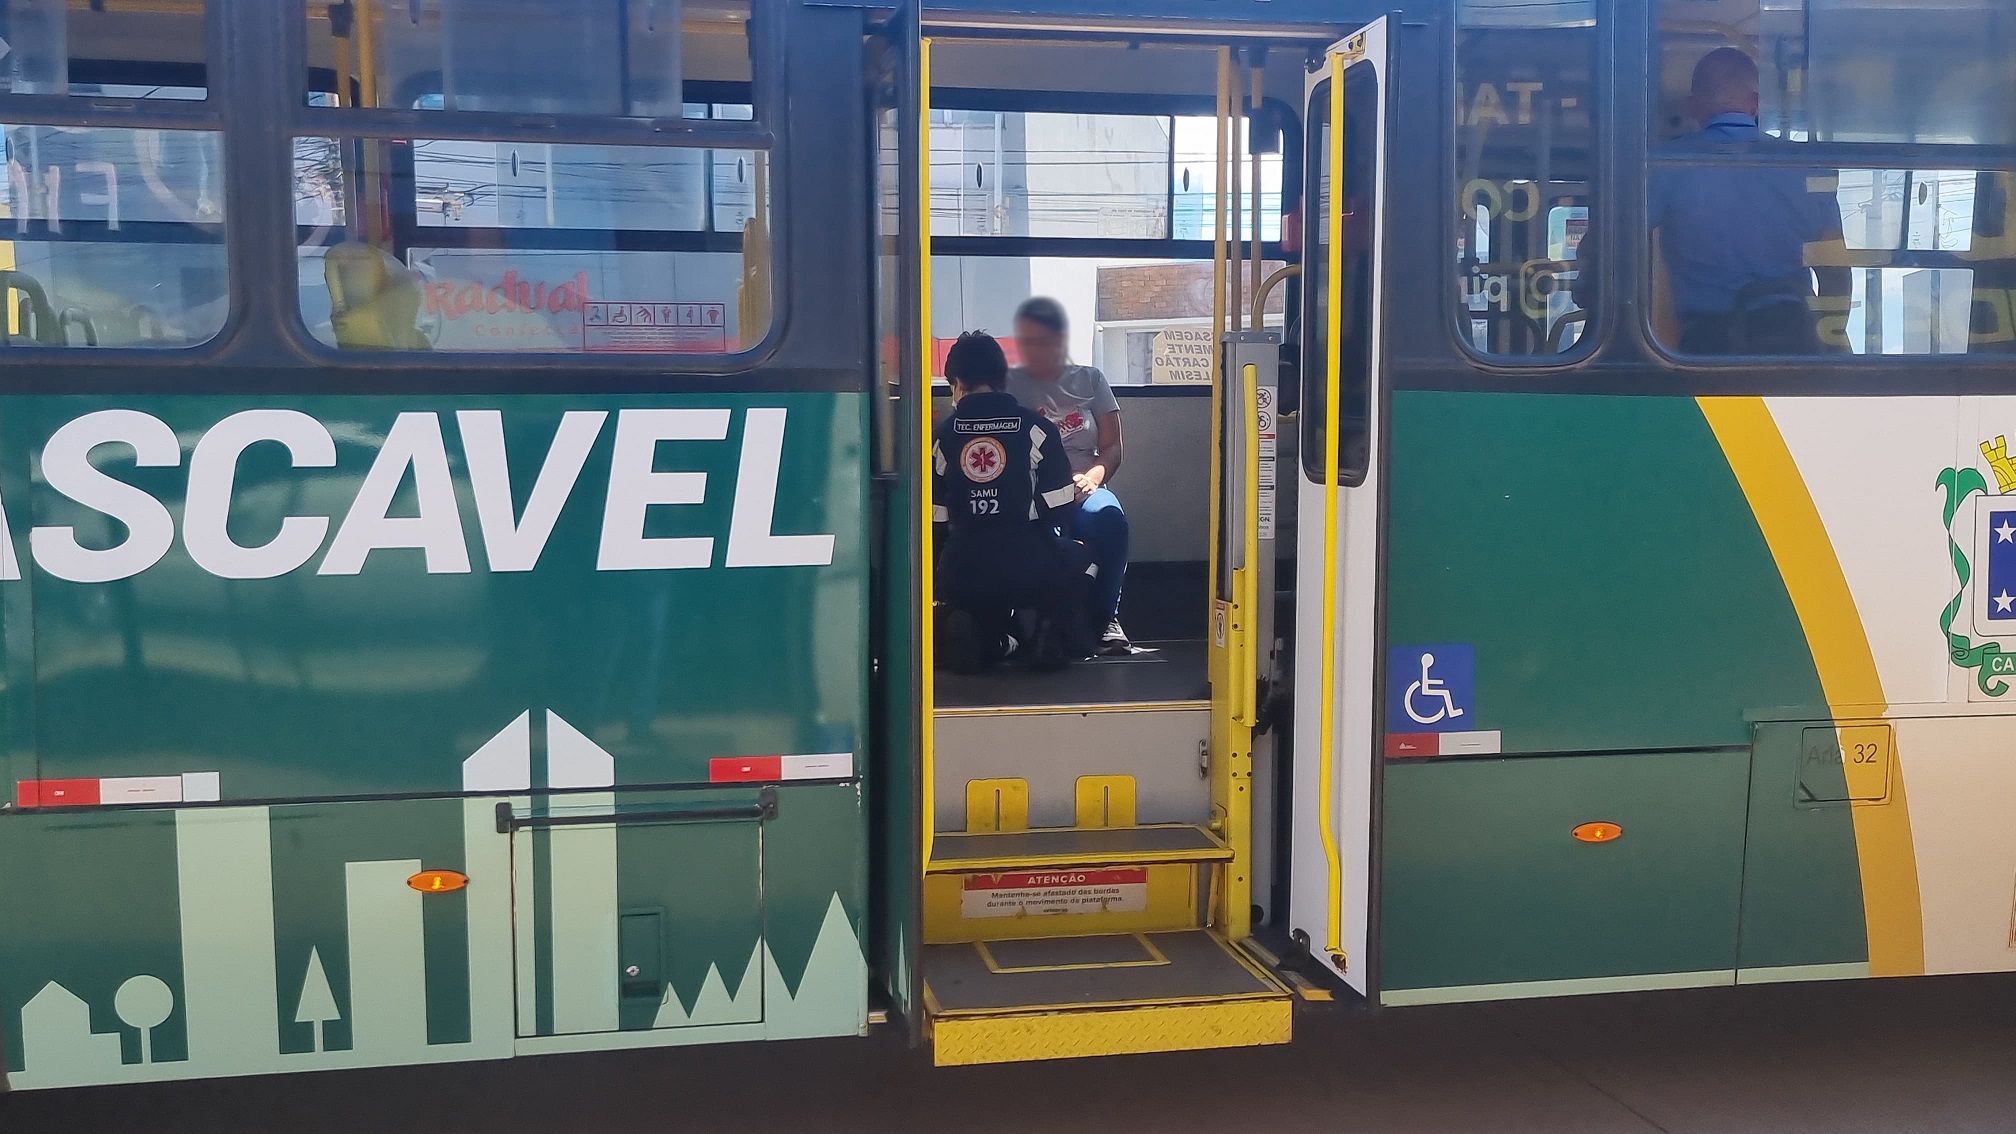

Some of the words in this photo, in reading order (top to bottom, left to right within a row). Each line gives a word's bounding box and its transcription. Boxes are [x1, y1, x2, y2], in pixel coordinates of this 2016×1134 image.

[973, 420, 1018, 431] ENFERMAGEM
[0, 406, 836, 583] SCAVEL
[970, 488, 998, 498] SAMU
[969, 499, 1000, 515] 192
[1853, 743, 1878, 764] 32
[1027, 873, 1086, 885] ATENÇÃO
[991, 890, 1041, 899] Mantenha-se
[1043, 888, 1077, 898] afastado
[1078, 887, 1092, 896] das
[1094, 886, 1120, 895] bordas
[986, 900, 1016, 908] durante
[1025, 897, 1068, 906] movimento
